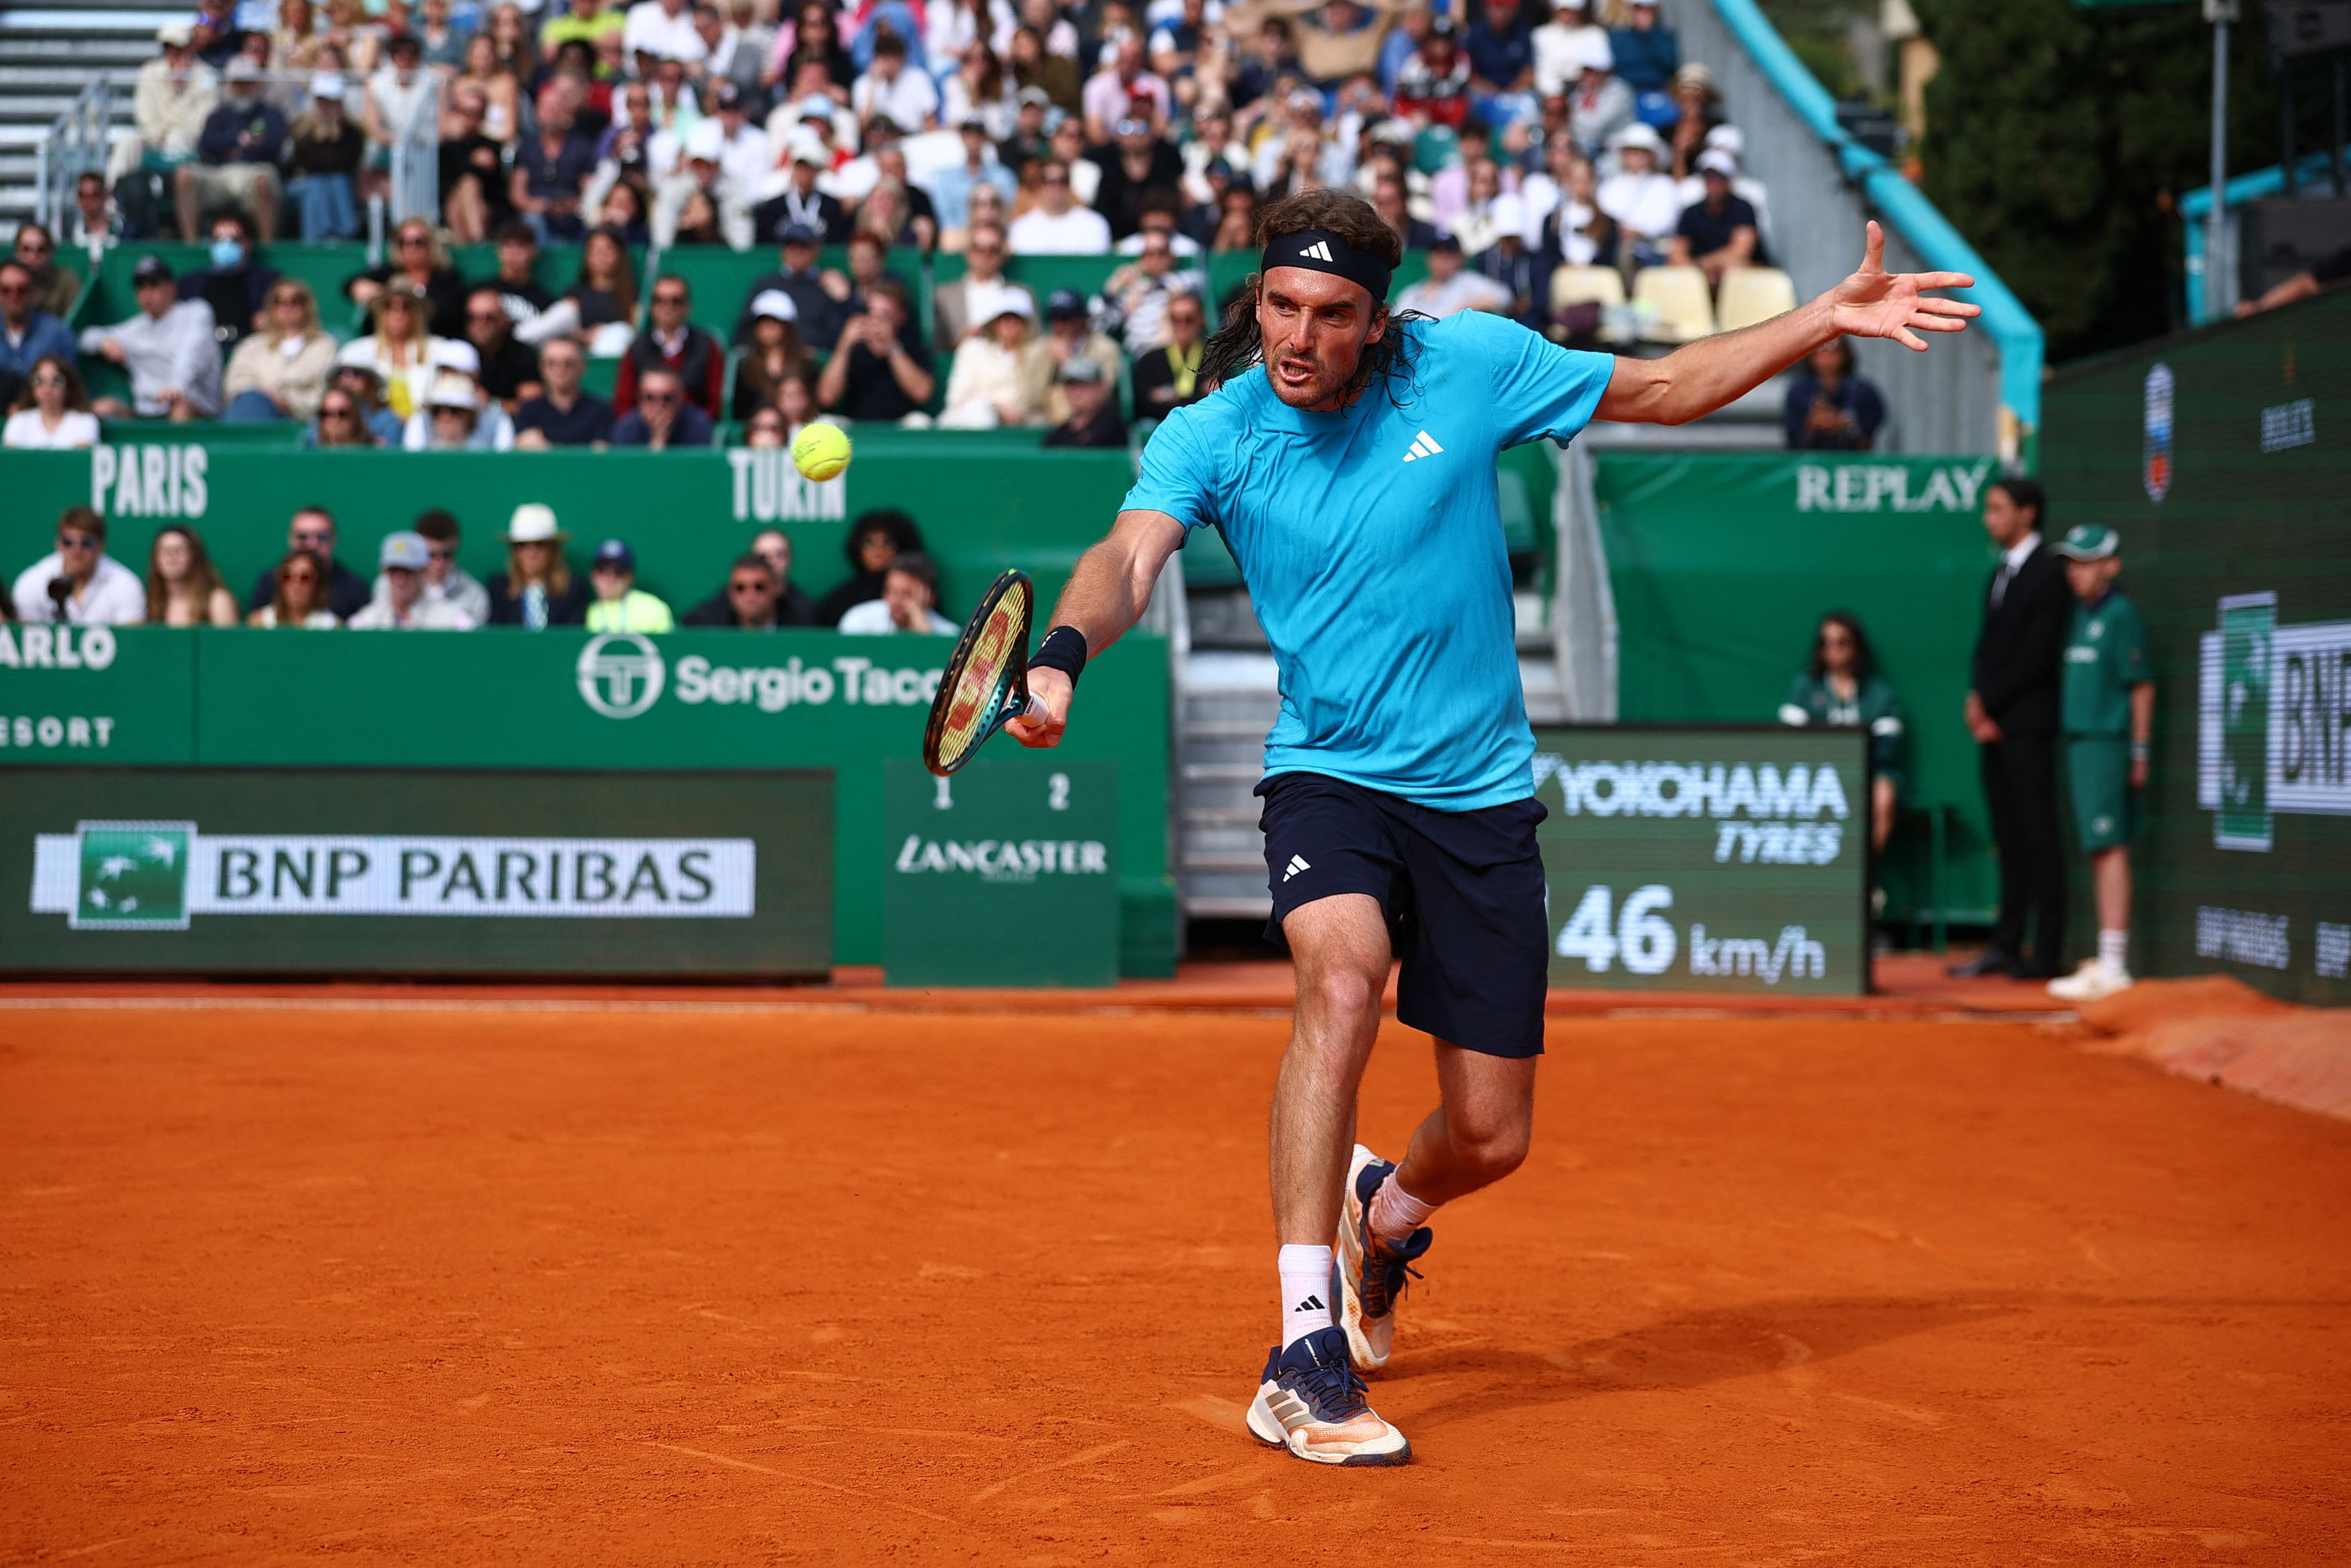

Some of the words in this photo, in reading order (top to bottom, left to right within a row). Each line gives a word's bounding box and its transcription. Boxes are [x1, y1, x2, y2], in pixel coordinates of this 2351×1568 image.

[91, 444, 209, 518] PARIS
[727, 448, 848, 521] TURIN
[1795, 463, 1992, 513] REPLAY
[0, 625, 117, 671] ARLO
[674, 655, 835, 713] Sergio
[932, 775, 954, 810] 1
[1047, 772, 1071, 811] 2
[1558, 760, 1850, 821] YOKOHAMA
[895, 834, 1108, 876] LANCASTER
[1714, 821, 1844, 866] TYRES
[216, 848, 370, 900] BNP
[399, 849, 713, 903] PARIBAS
[1546, 883, 1679, 976] 46
[1689, 921, 1827, 986] km/h
